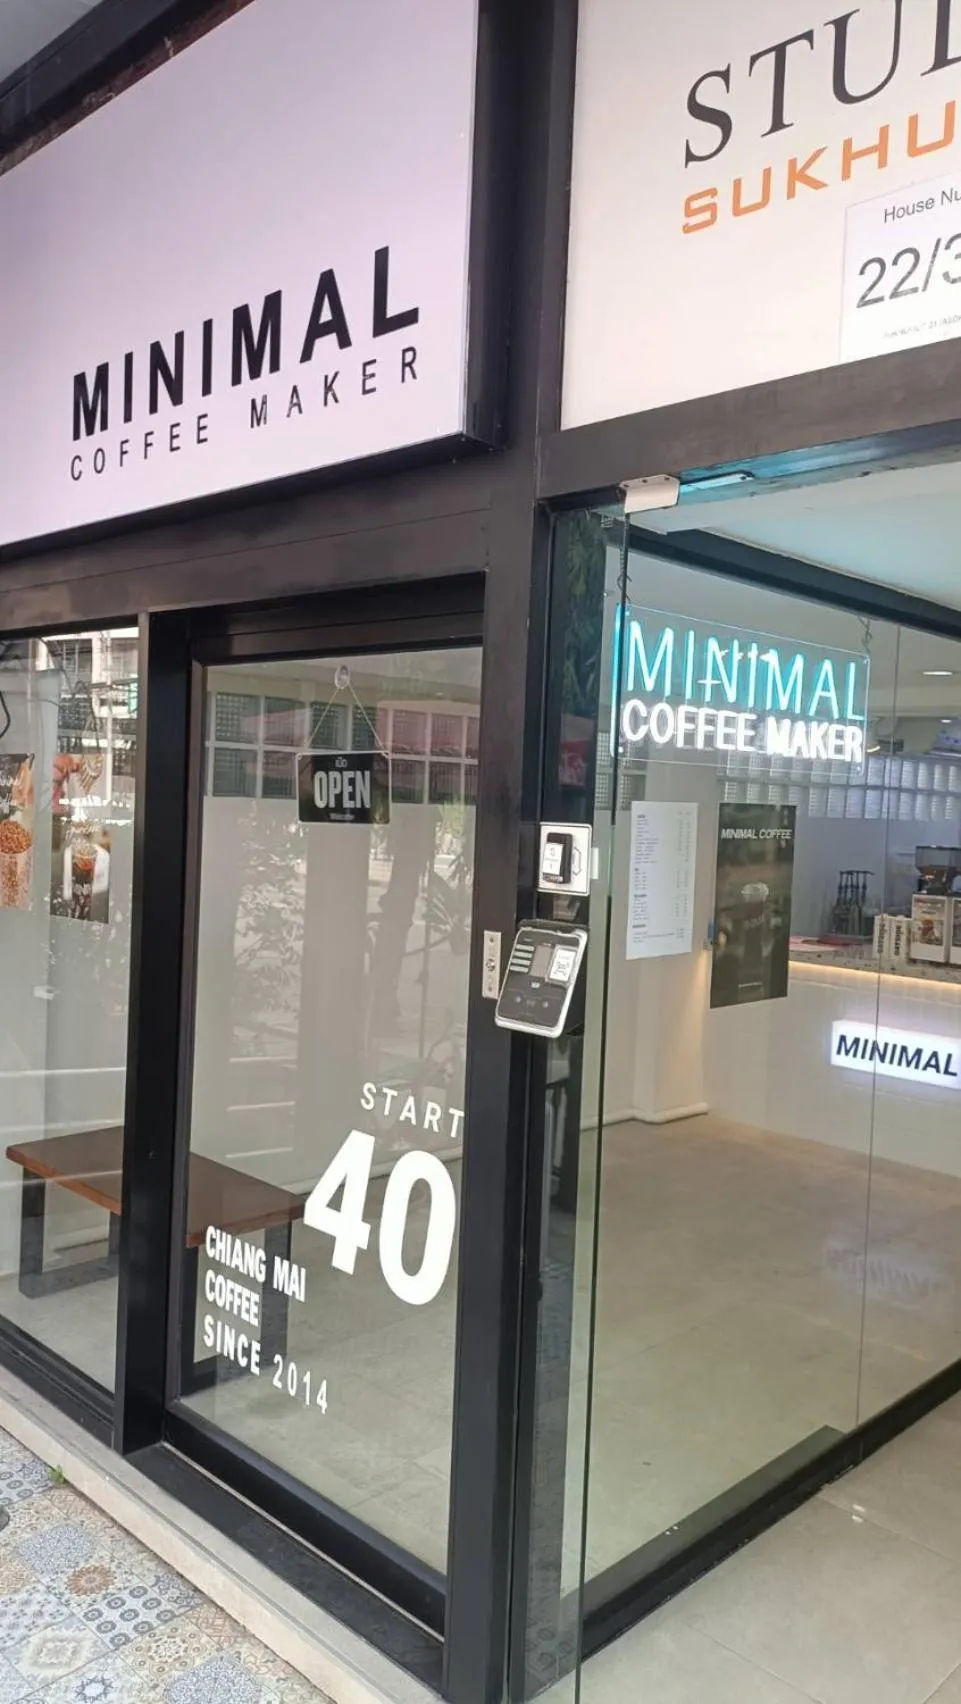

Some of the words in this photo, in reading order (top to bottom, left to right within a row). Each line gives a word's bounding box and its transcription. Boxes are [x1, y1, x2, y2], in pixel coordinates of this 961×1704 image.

[682, 100, 956, 234] SUKHU
[884, 197, 935, 224] House
[857, 233, 961, 309] 22/3
[73, 246, 419, 441] MINIMAL
[71, 414, 209, 481] COFFEE
[250, 346, 418, 429] MAKER
[627, 620, 865, 721] MINIMAL
[622, 698, 758, 752] COFFEE
[765, 715, 863, 763] MAKER
[314, 770, 371, 809] OPEN
[721, 828, 757, 840] MINIMAL
[758, 828, 793, 840] COFFEE
[836, 1034, 958, 1077] MINIMAL
[360, 1082, 465, 1138] START
[303, 1129, 456, 1305] 40
[205, 1225, 267, 1283] CHIANG
[273, 1256, 307, 1302] MAI
[205, 1269, 260, 1327] COFFEE
[203, 1314, 261, 1376] SINCE
[273, 1354, 328, 1414] 2014
